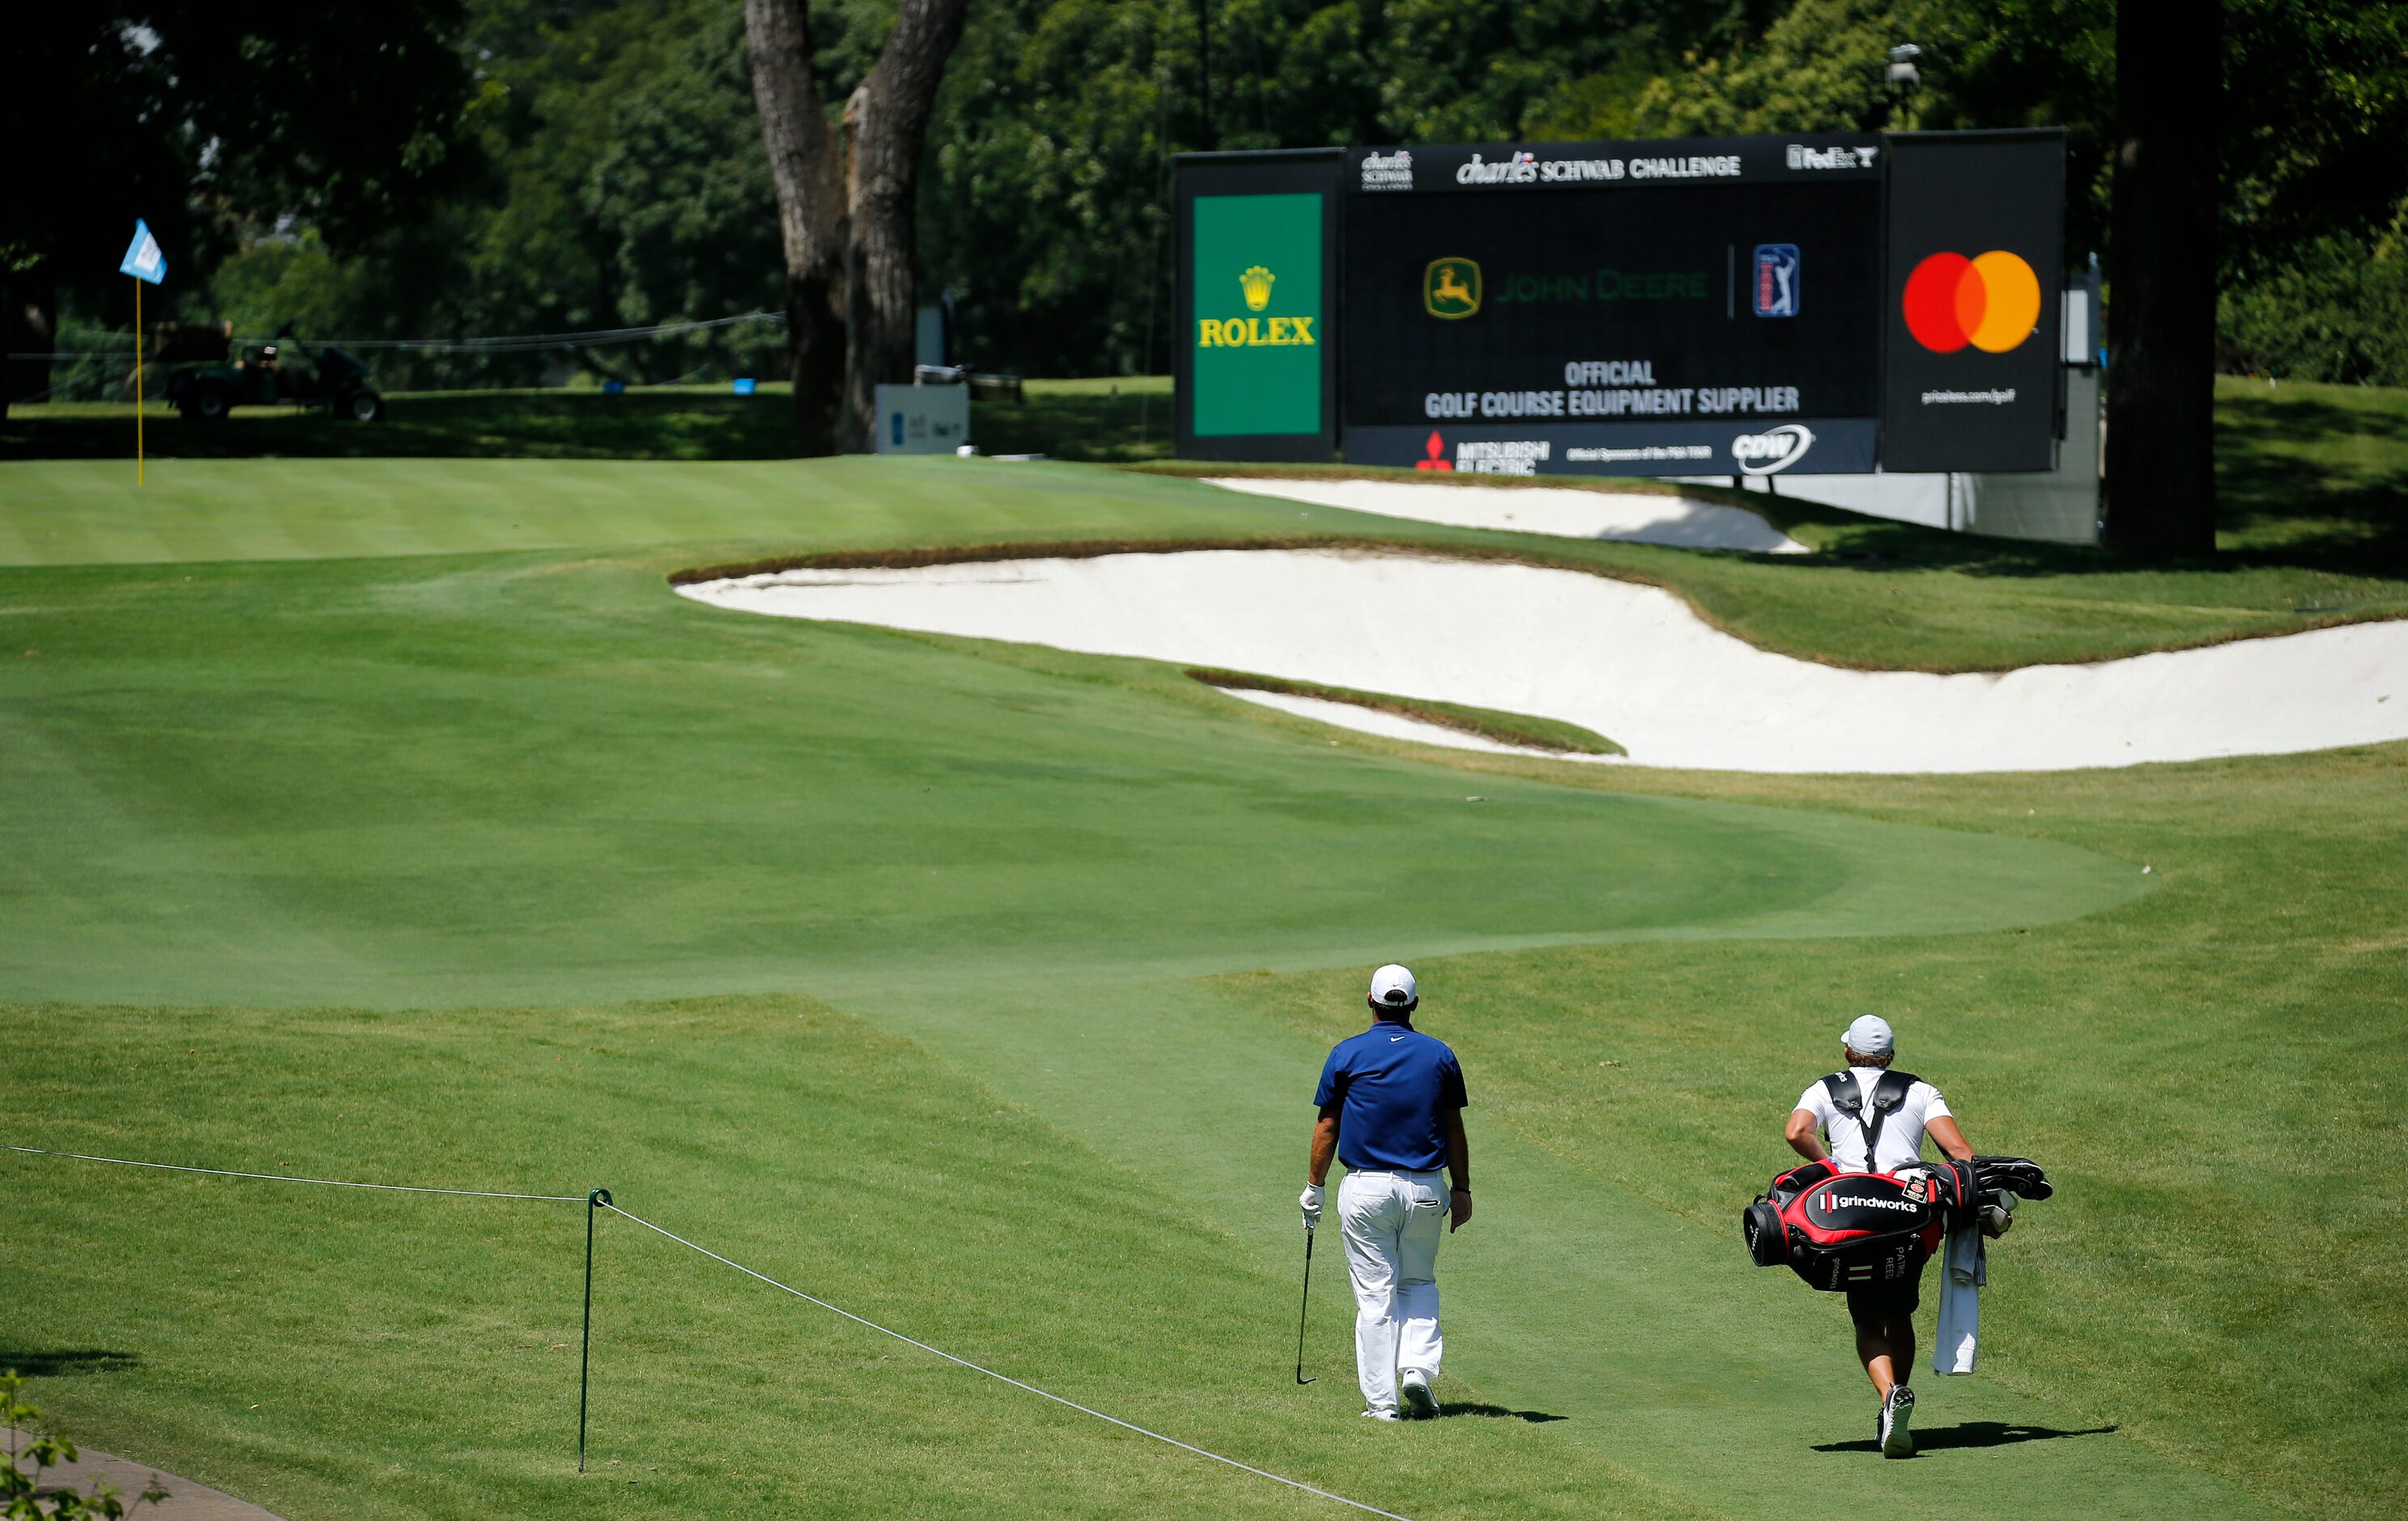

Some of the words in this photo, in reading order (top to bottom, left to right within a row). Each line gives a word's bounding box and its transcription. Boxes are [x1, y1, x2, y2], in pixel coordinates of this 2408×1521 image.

[1457, 151, 1539, 184] charles
[1540, 160, 1624, 181] SCHWAB
[1629, 156, 1741, 179] CHALLENGE
[1802, 147, 1857, 169] FedEx
[1198, 317, 1316, 347] ROLEX
[1564, 360, 1656, 386] OFFICIAL
[1424, 392, 1478, 417] GOLF
[1481, 390, 1565, 417] COURSE
[1568, 388, 1694, 415] EQUIPMENT
[1697, 386, 1799, 412] SUPPLIER
[1921, 388, 2016, 405] priceless.com/golf
[1457, 441, 1550, 461] MITSUBISHI
[1731, 434, 1795, 459] CDW
[1839, 1195, 1917, 1213] grindworks
[1830, 1258, 1840, 1289] grindworks
